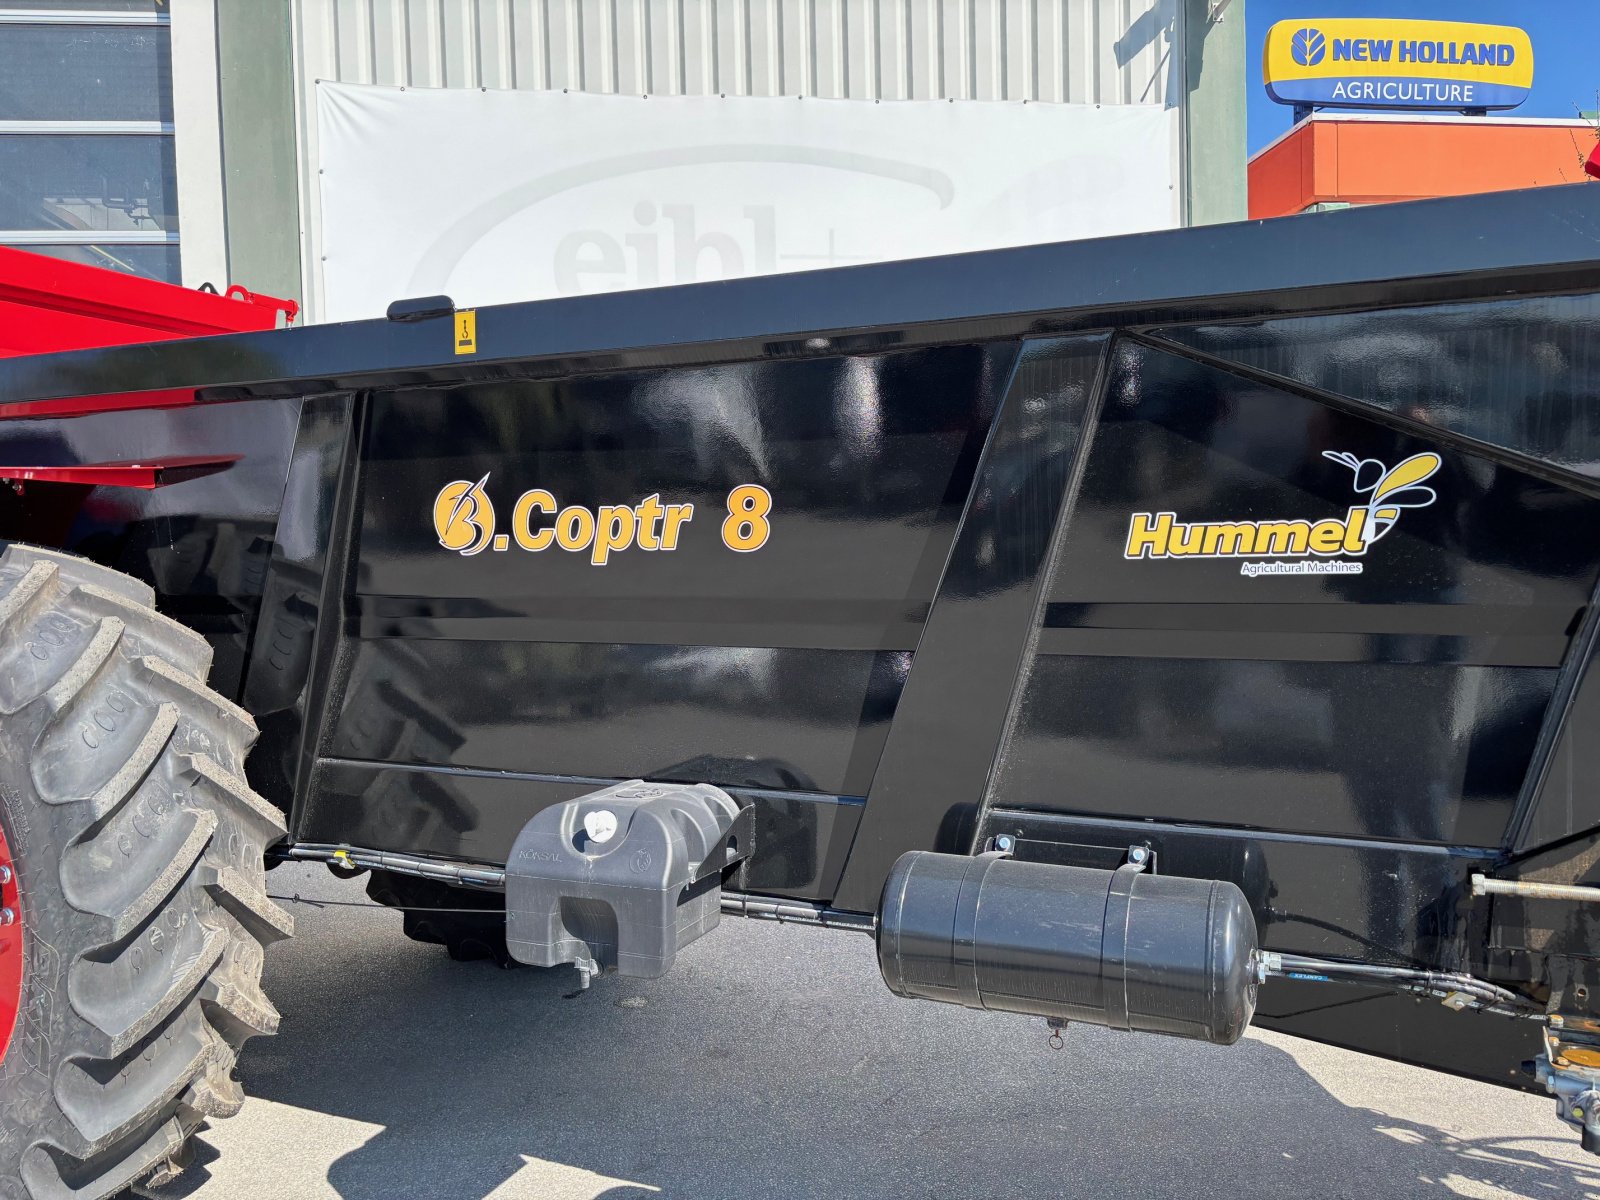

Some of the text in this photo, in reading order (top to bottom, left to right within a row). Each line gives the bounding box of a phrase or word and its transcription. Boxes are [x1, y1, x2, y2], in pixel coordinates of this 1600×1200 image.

[1332, 39, 1515, 66] NEW HOLLAND
[1332, 81, 1473, 102] AGRICULTURE
[721, 484, 772, 552] 8
[1124, 506, 1368, 559] Hummel
[1242, 561, 1362, 576] Agricultural Machines
